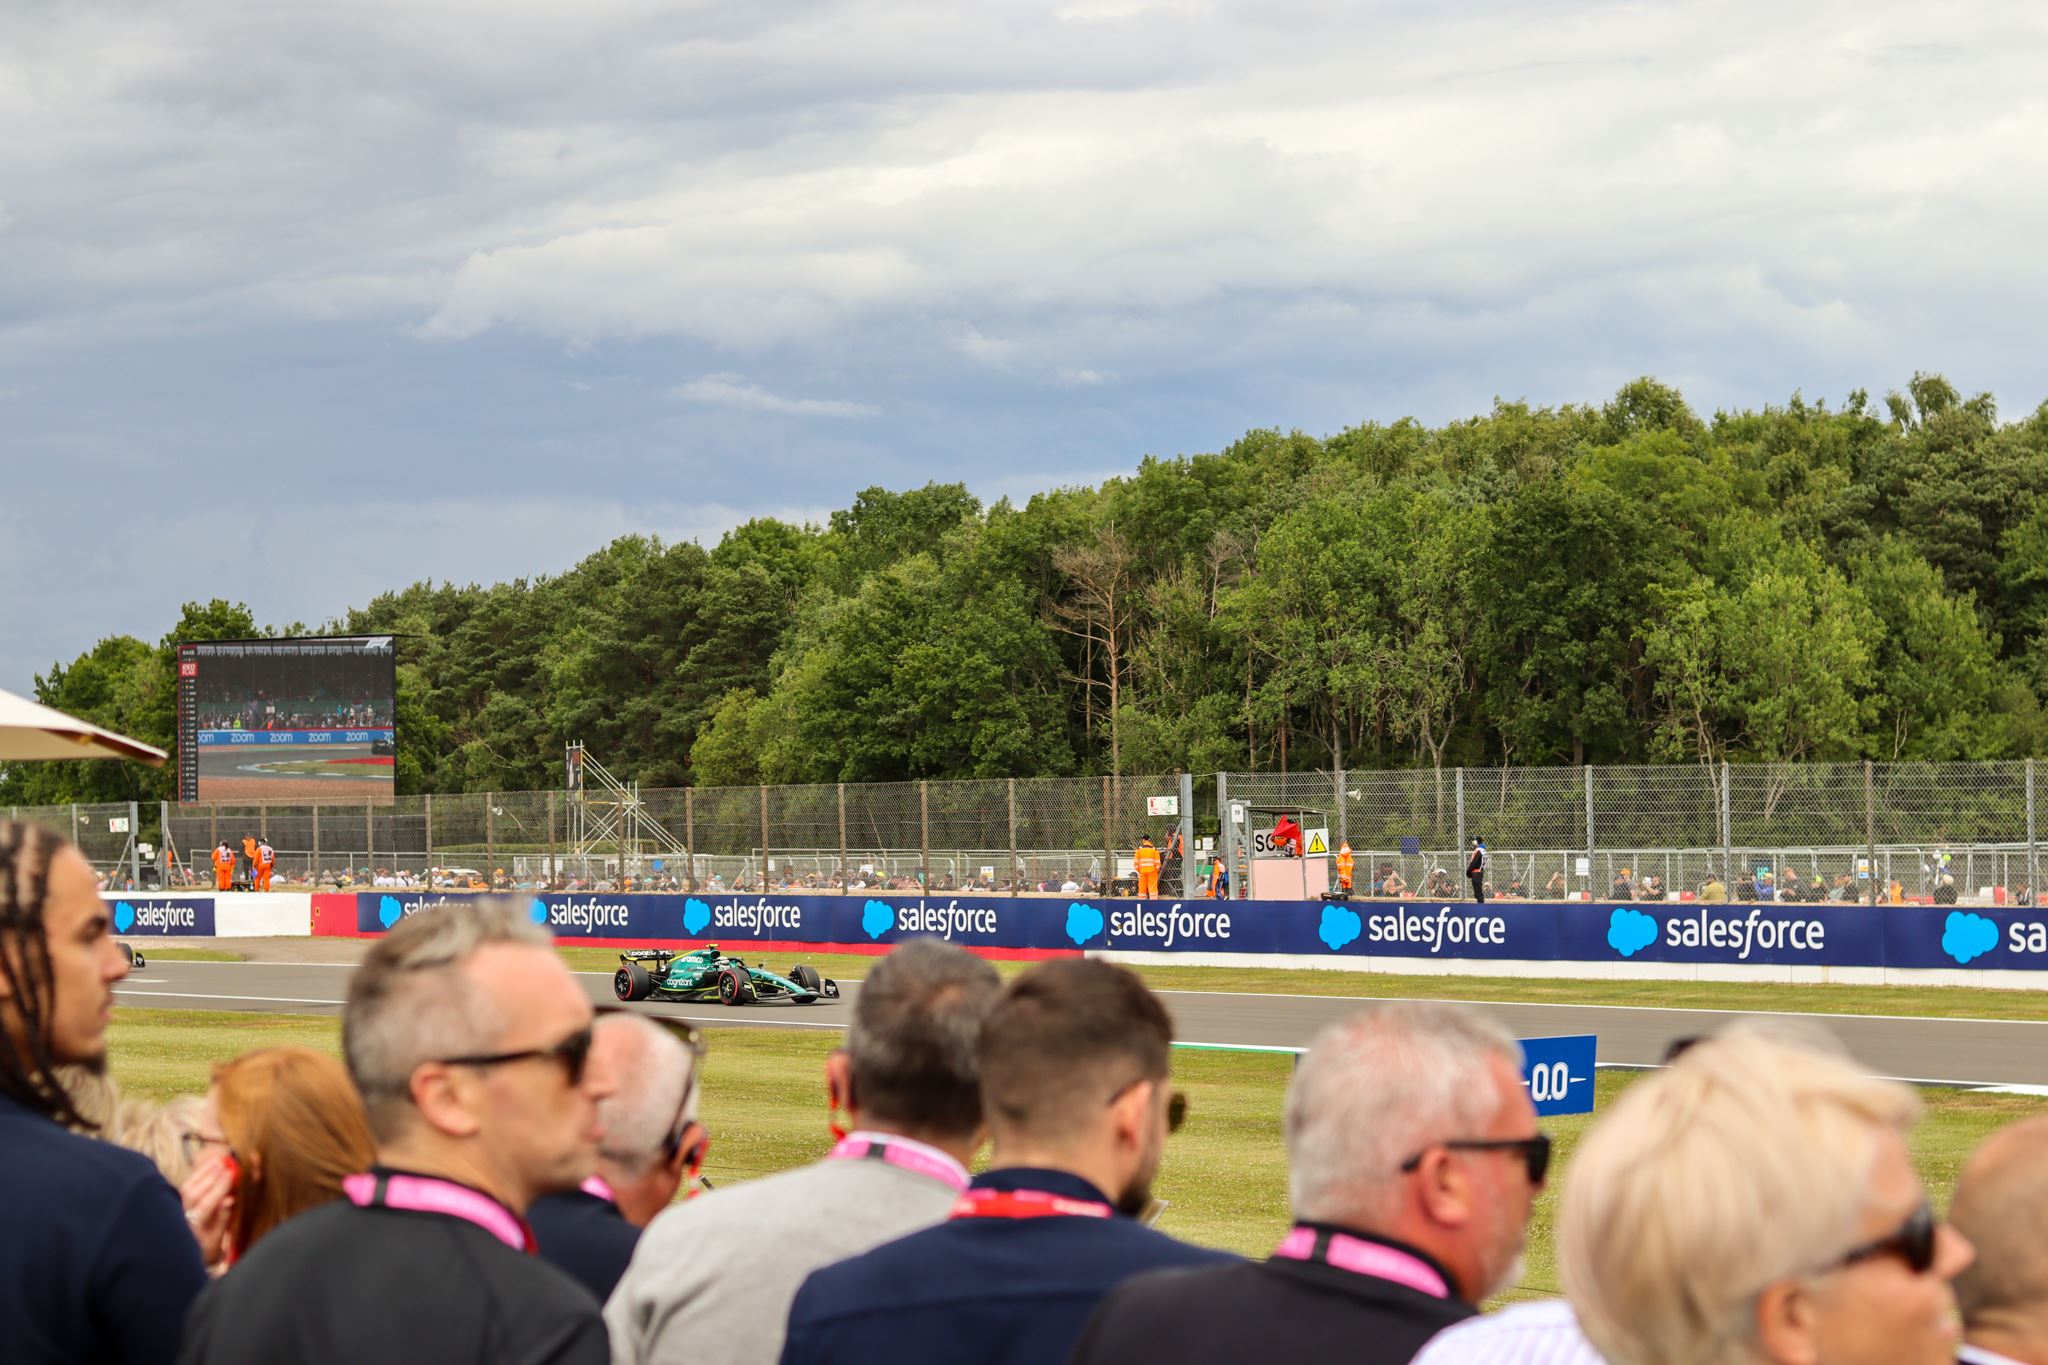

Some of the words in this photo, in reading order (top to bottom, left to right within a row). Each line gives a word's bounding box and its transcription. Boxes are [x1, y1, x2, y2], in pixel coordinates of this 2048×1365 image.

[231, 733, 254, 743] zoom
[270, 733, 293, 743] zoom
[308, 733, 331, 742] zoom
[346, 732, 368, 741] zoom
[136, 901, 194, 933] salesforce
[551, 897, 628, 933] salesforce
[714, 897, 801, 936] salesforce
[898, 899, 997, 941] salesforce
[1109, 903, 1231, 948] salesforce
[1368, 906, 1506, 953] salesforce
[1665, 909, 1825, 959] salesforce
[2009, 922, 2047, 953] sa
[1531, 1061, 1569, 1102] 0.0
